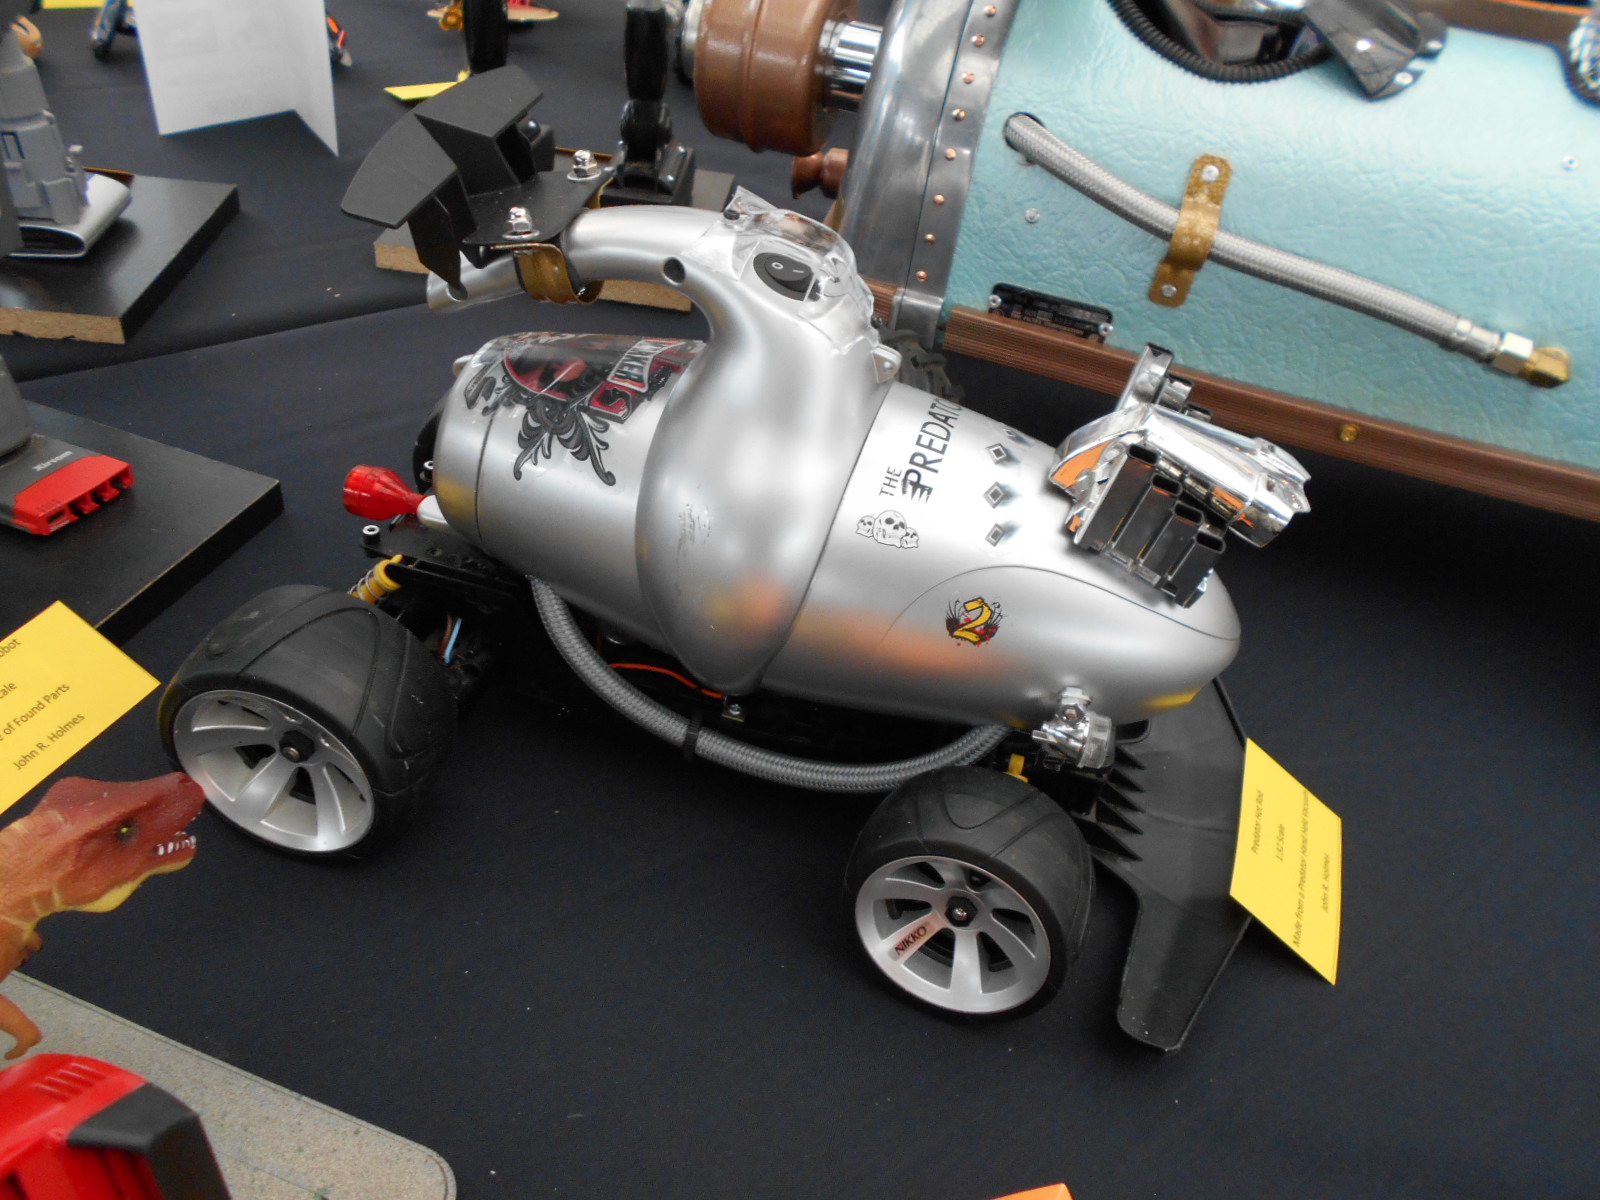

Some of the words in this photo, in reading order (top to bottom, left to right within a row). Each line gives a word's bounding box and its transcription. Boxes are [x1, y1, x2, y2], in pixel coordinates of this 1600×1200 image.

[878, 466, 903, 497] THE
[952, 596, 993, 646] 2
[3, 723, 16, 736] of
[13, 701, 46, 727] Found
[43, 683, 70, 704] Parts
[13, 749, 40, 771] John
[36, 741, 51, 752] R.
[49, 713, 86, 742] Holmes
[1251, 819, 1262, 855] Predator
[1277, 823, 1286, 842] Scale
[1298, 855, 1307, 891] Predator
[1322, 852, 1330, 882] Holmes
[1295, 897, 1304, 920] from
[1321, 891, 1329, 914] John
[894, 926, 927, 956] NIKKO
[1292, 919, 1302, 947] Made
